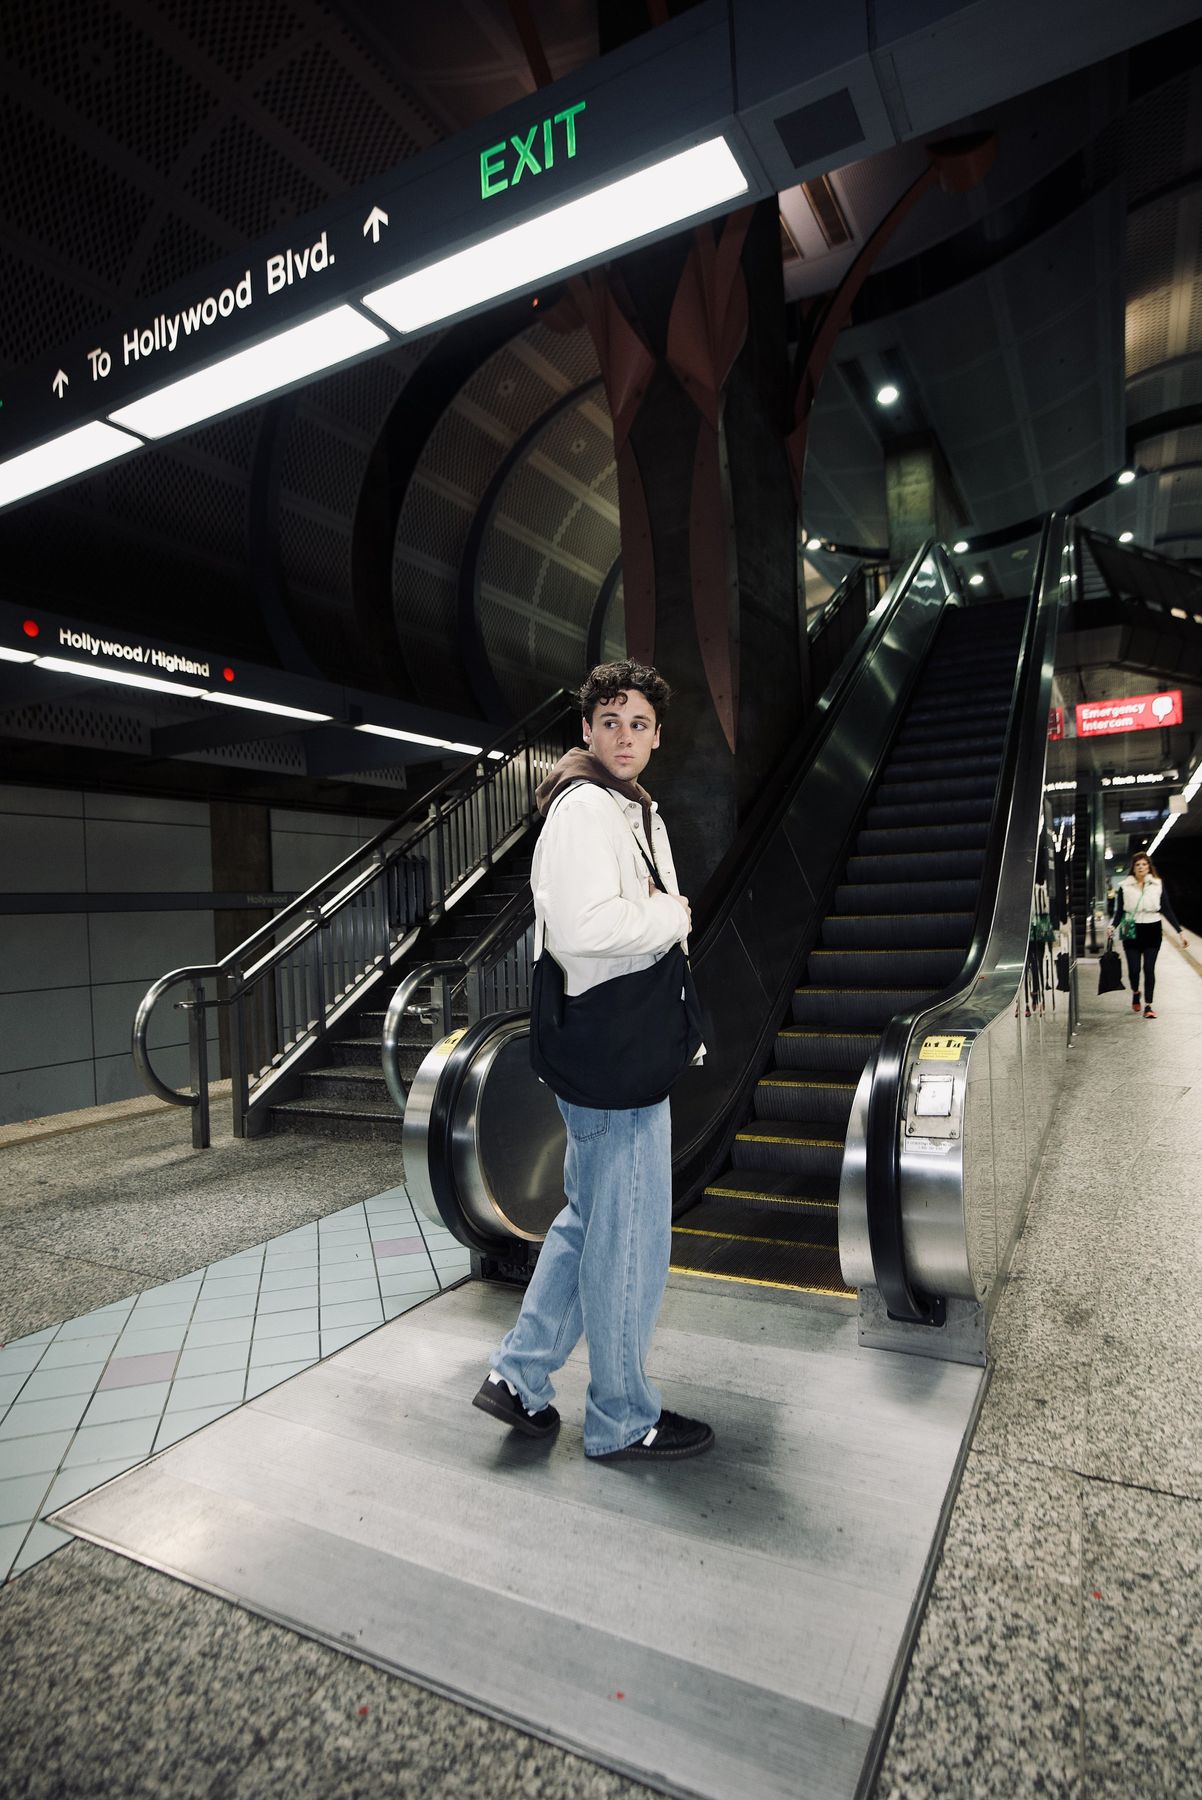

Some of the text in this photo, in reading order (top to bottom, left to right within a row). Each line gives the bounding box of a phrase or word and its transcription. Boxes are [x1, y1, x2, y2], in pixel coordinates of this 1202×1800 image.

[479, 100, 587, 200] EXIT
[87, 231, 336, 382] To Hollywood Blvd.
[1082, 702, 1146, 720] Emergency
[1082, 717, 1134, 732] Intercom
[246, 894, 288, 906] Hollywood
